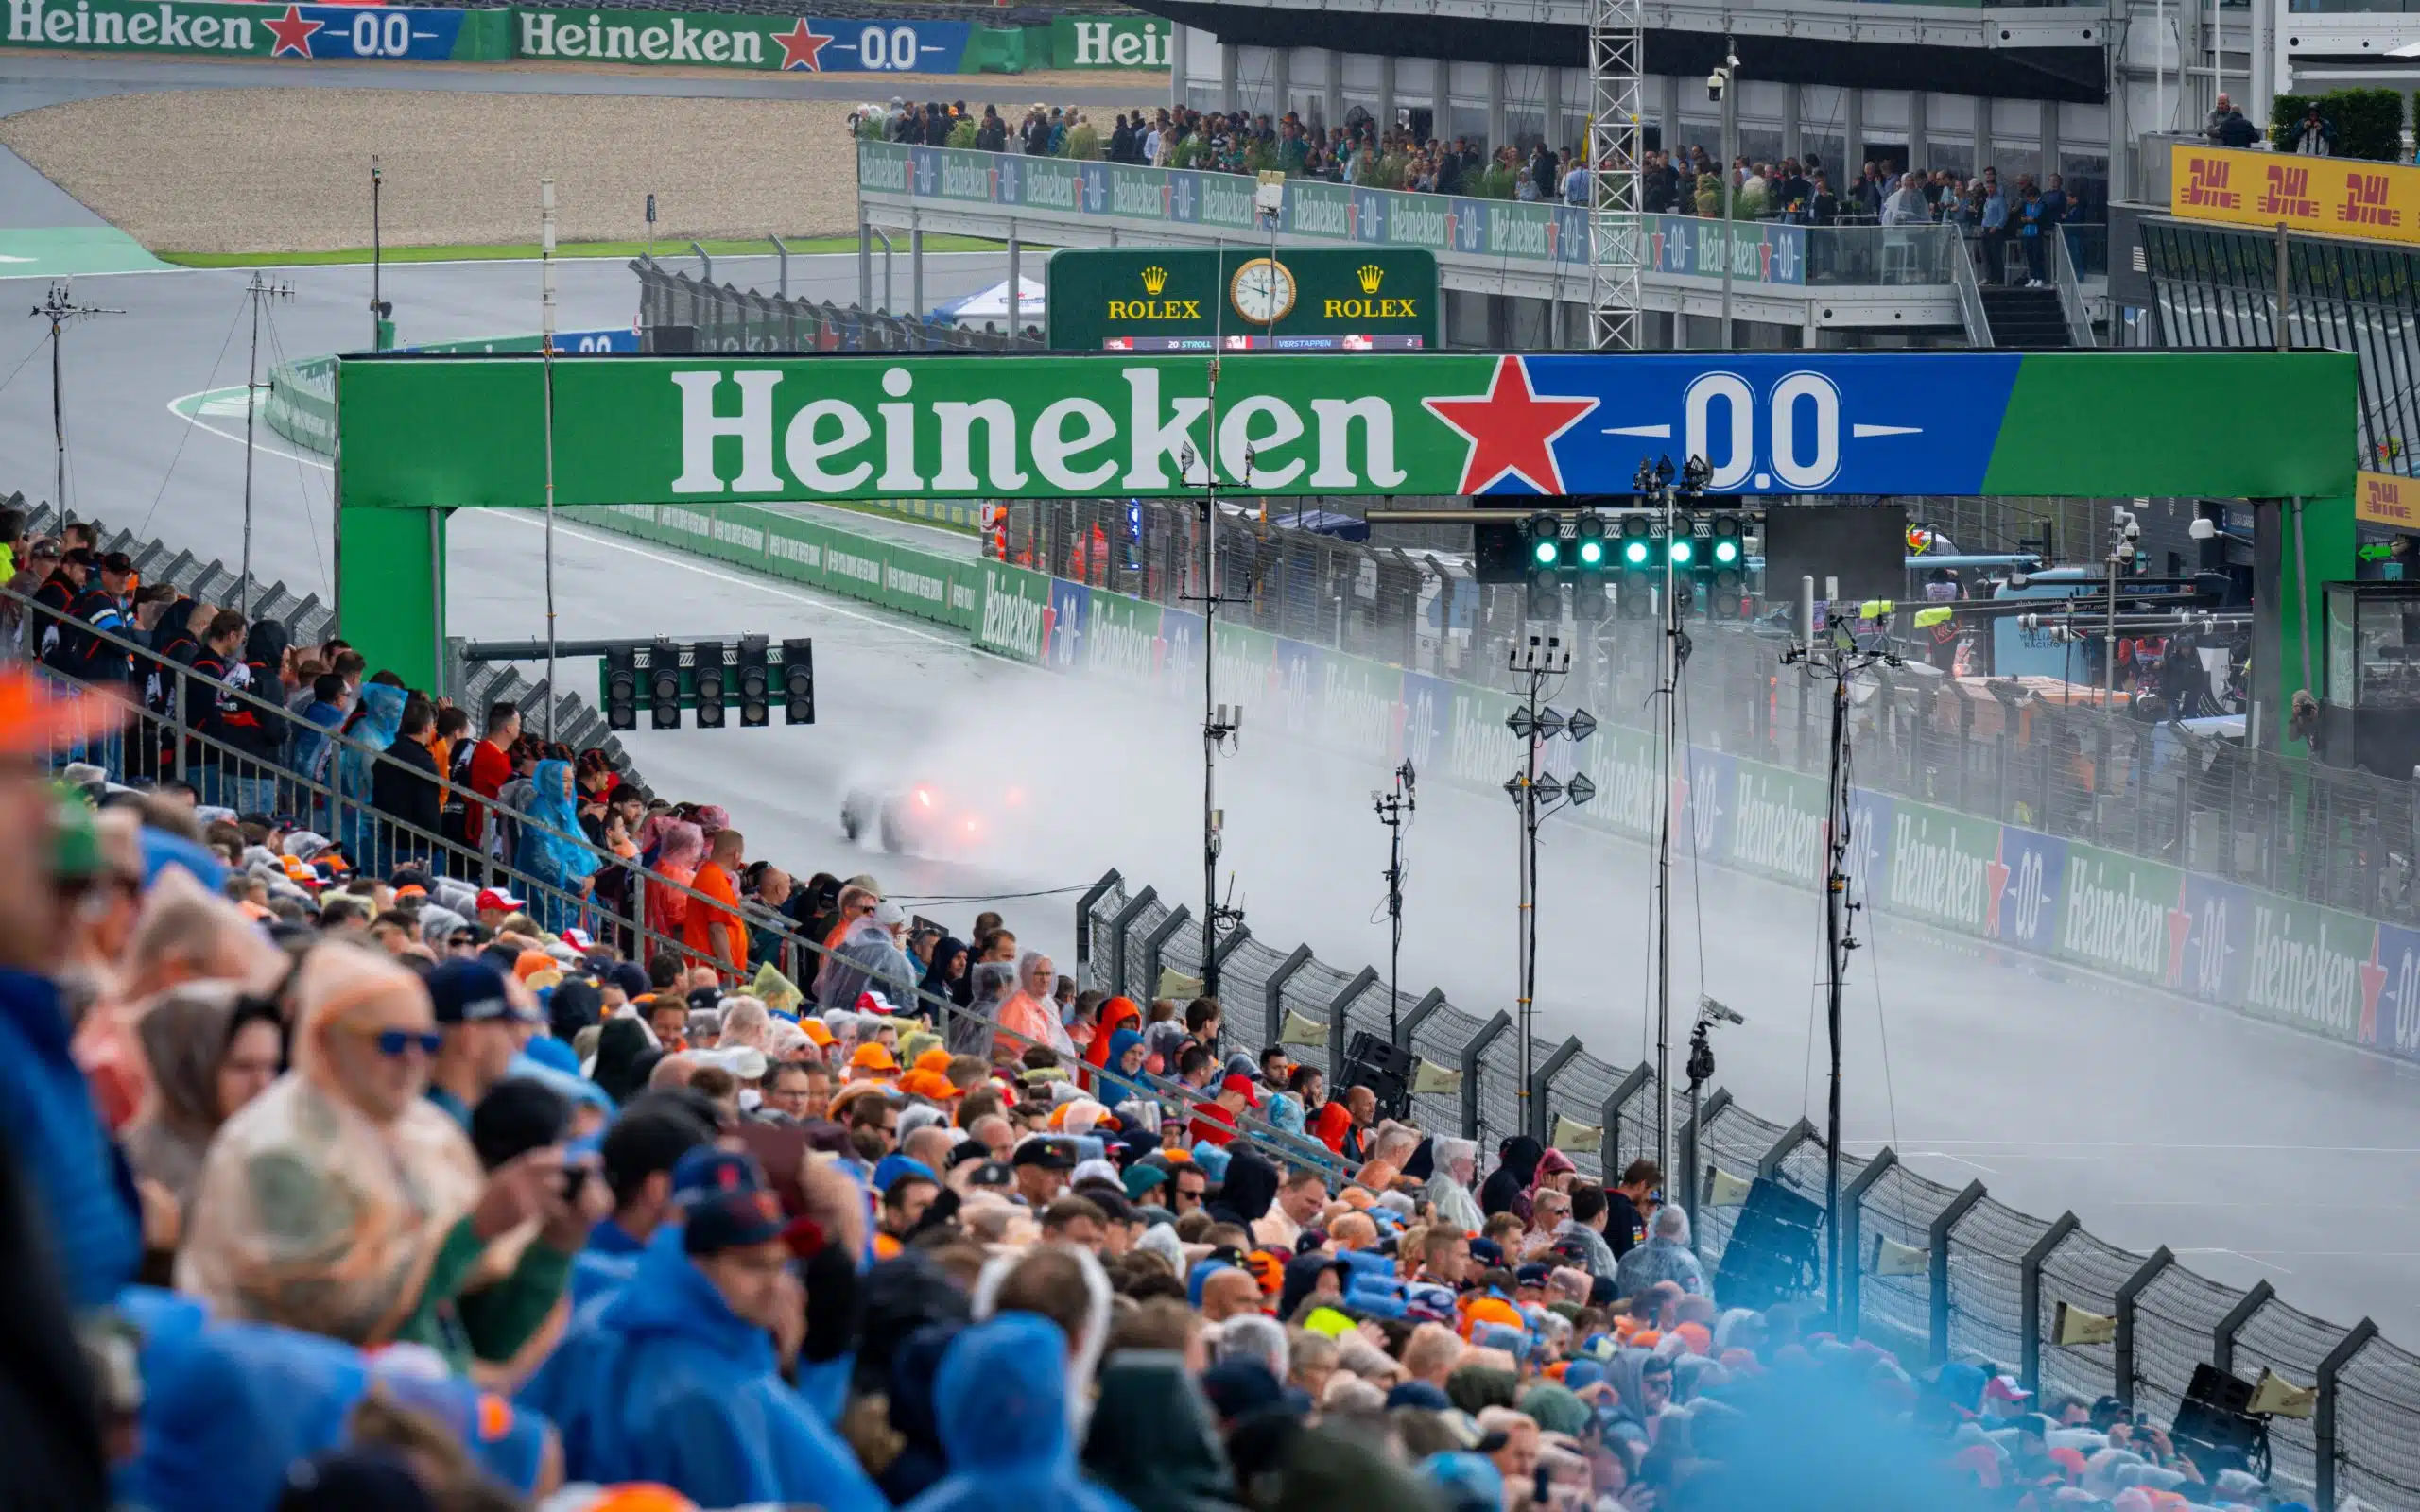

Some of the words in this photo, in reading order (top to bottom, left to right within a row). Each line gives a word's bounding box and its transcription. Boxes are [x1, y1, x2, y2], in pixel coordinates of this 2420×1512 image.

[8, 0, 253, 49] Heineken
[353, 11, 409, 56] 0.0
[520, 12, 764, 63] Heineken
[861, 26, 916, 69] 0.0
[860, 146, 904, 189] Heineken
[942, 155, 988, 198] Heineken
[1026, 163, 1073, 206] Heineken
[2186, 159, 2237, 209] DHL
[2263, 165, 2314, 218] DHL
[1113, 171, 1161, 215] Heineken
[1202, 179, 1252, 224] Heineken
[1294, 188, 1346, 234] Heineken
[2342, 174, 2395, 226] DHL
[1390, 197, 1443, 245] Heineken
[1491, 208, 1546, 254] Heineken
[1697, 226, 1757, 276] Heinken
[1108, 300, 1201, 319] ROLEX
[1323, 298, 1417, 318] ROLEX
[1168, 340, 1179, 349] 20
[1181, 340, 1212, 349] STROLL
[1279, 339, 1332, 348] VERSTAPPEN
[670, 367, 1408, 493] Heineken
[1684, 371, 1841, 490] 0.0
[982, 570, 1040, 656] Heineken
[1734, 771, 1816, 880] Heineken
[1892, 813, 1982, 924] Heineken
[2064, 856, 2163, 975] Heineken
[2247, 906, 2355, 1030] Heineken
